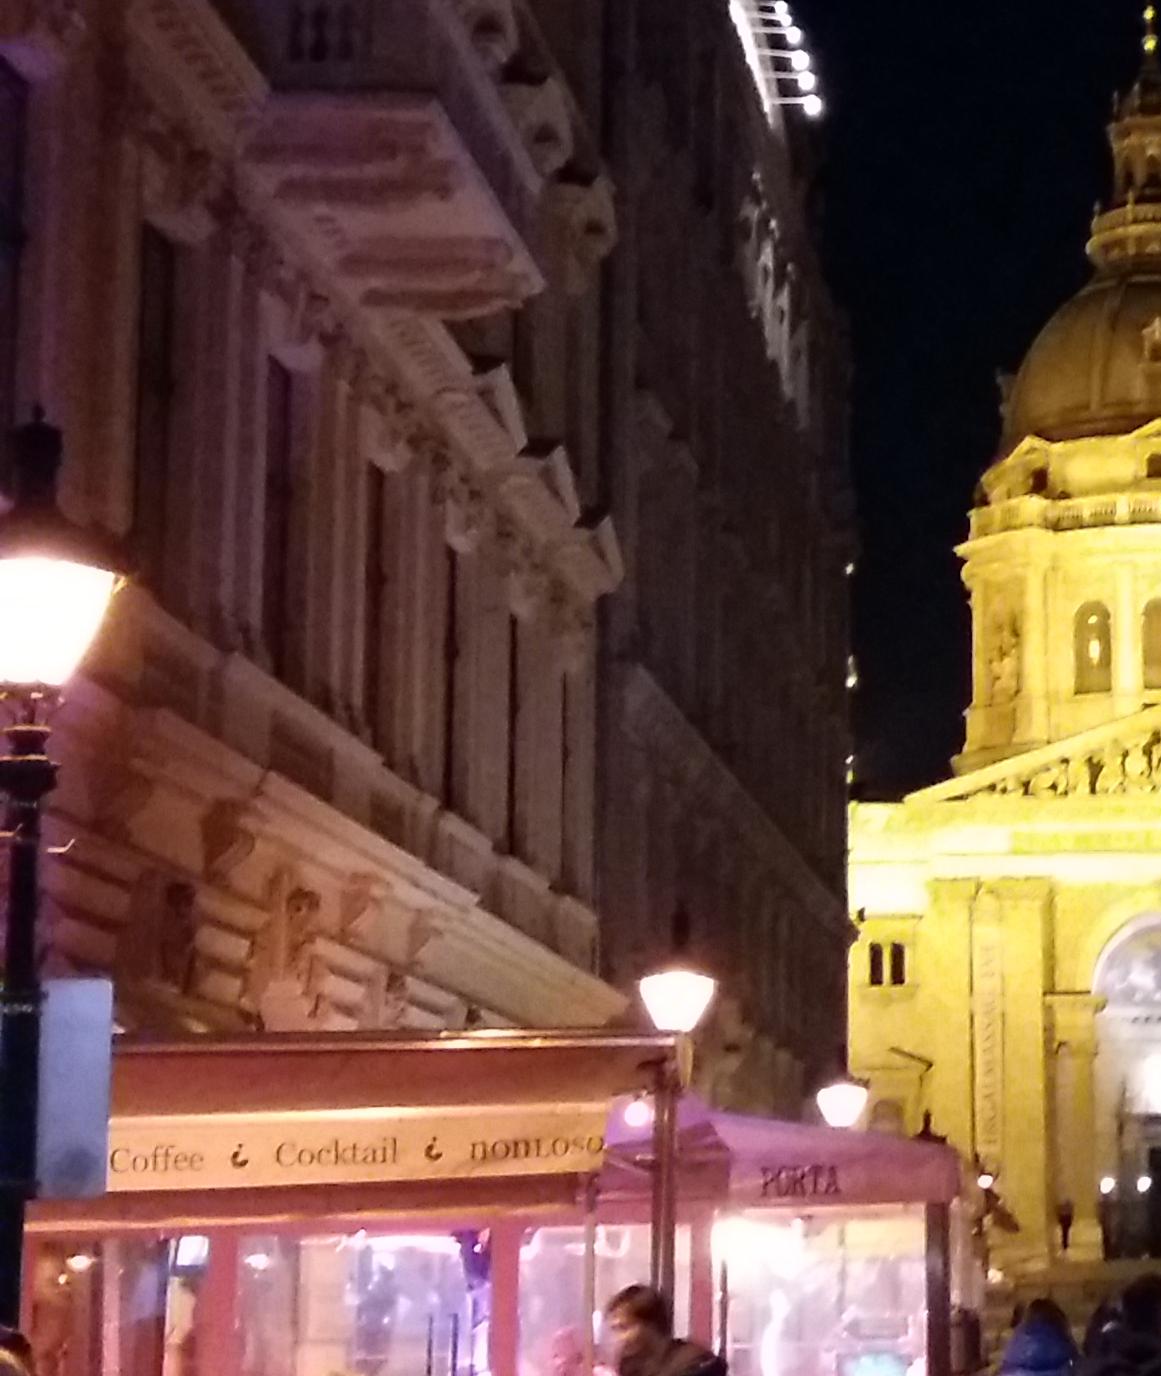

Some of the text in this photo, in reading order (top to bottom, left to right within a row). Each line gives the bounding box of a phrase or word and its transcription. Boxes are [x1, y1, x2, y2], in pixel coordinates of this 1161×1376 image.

[110, 1143, 204, 1173] Coffee
[276, 1136, 397, 1167] Cocktail
[760, 1164, 842, 1199] PORTA
